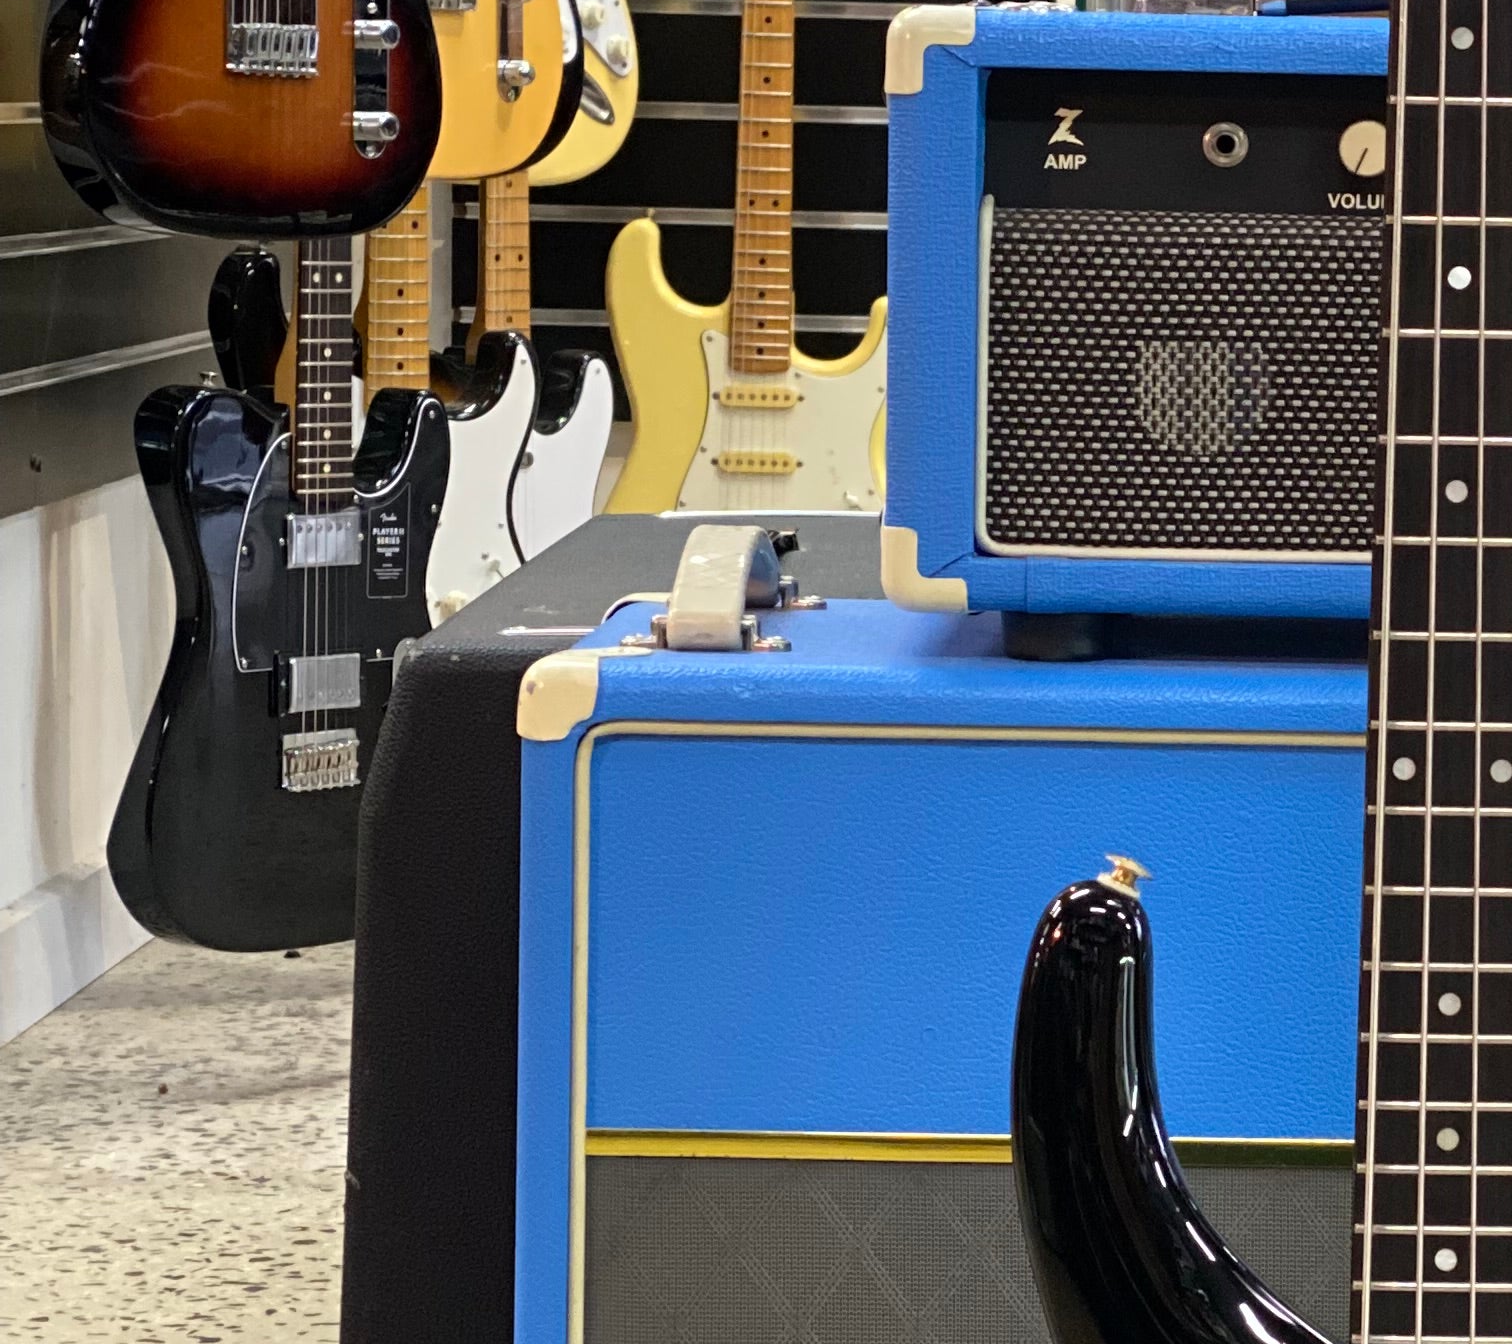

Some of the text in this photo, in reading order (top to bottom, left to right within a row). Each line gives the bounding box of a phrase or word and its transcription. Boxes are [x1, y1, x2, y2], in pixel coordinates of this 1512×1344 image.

[1044, 154, 1087, 170] AMP
[1327, 193, 1384, 209] VOLU
[372, 527, 398, 536] PLAYER
